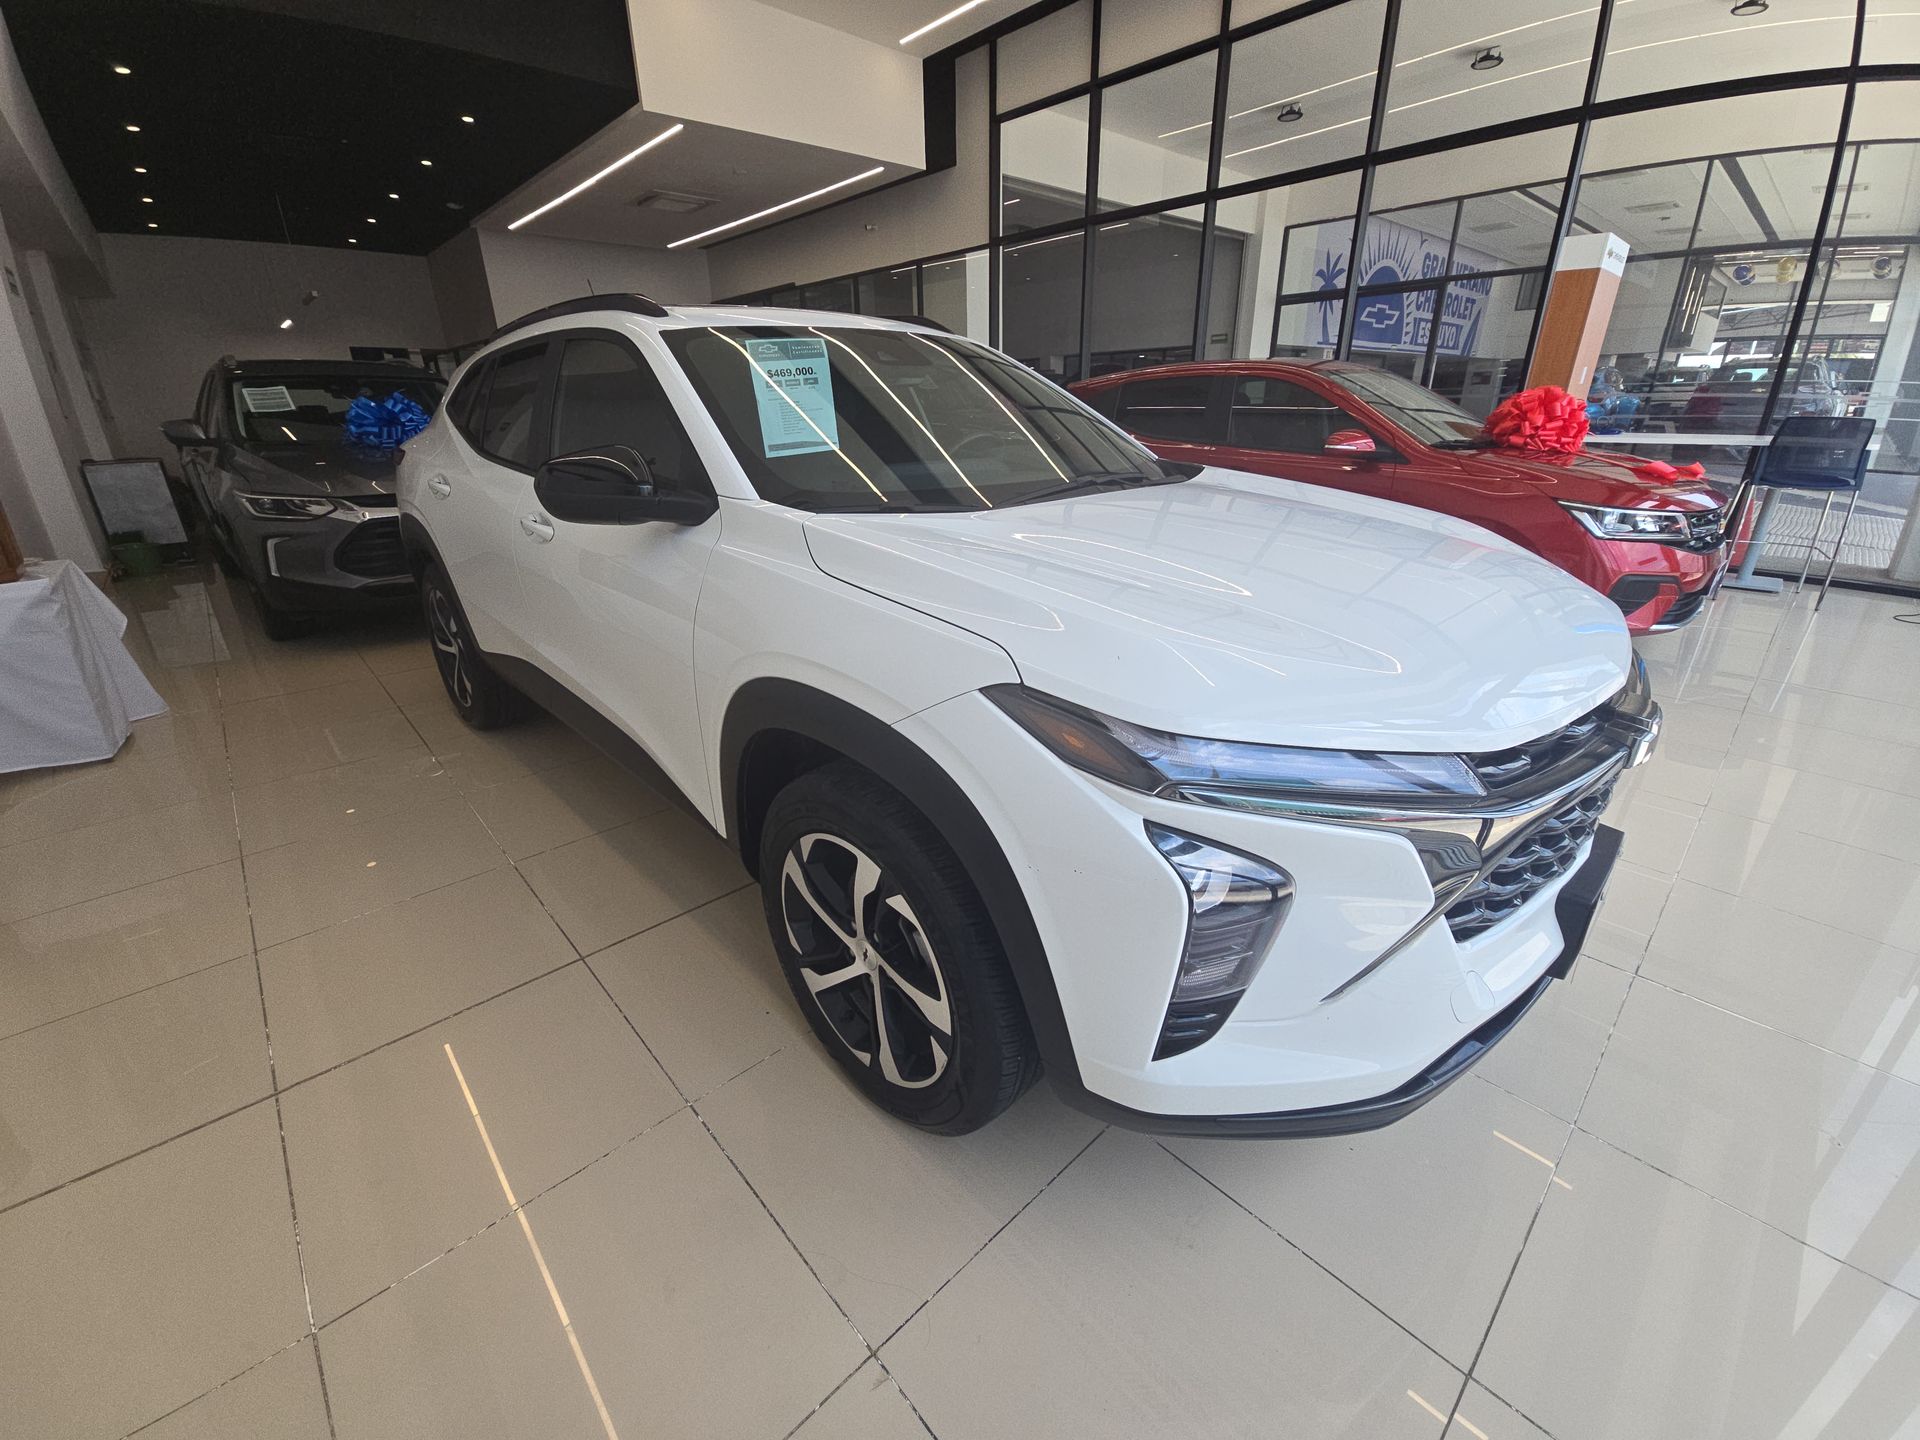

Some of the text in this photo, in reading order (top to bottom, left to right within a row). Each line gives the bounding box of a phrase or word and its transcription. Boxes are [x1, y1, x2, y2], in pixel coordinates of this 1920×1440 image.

[1422, 252, 1454, 280] GRA
[1416, 287, 1476, 320] CHROLET
[1431, 324, 1456, 347] UYO
